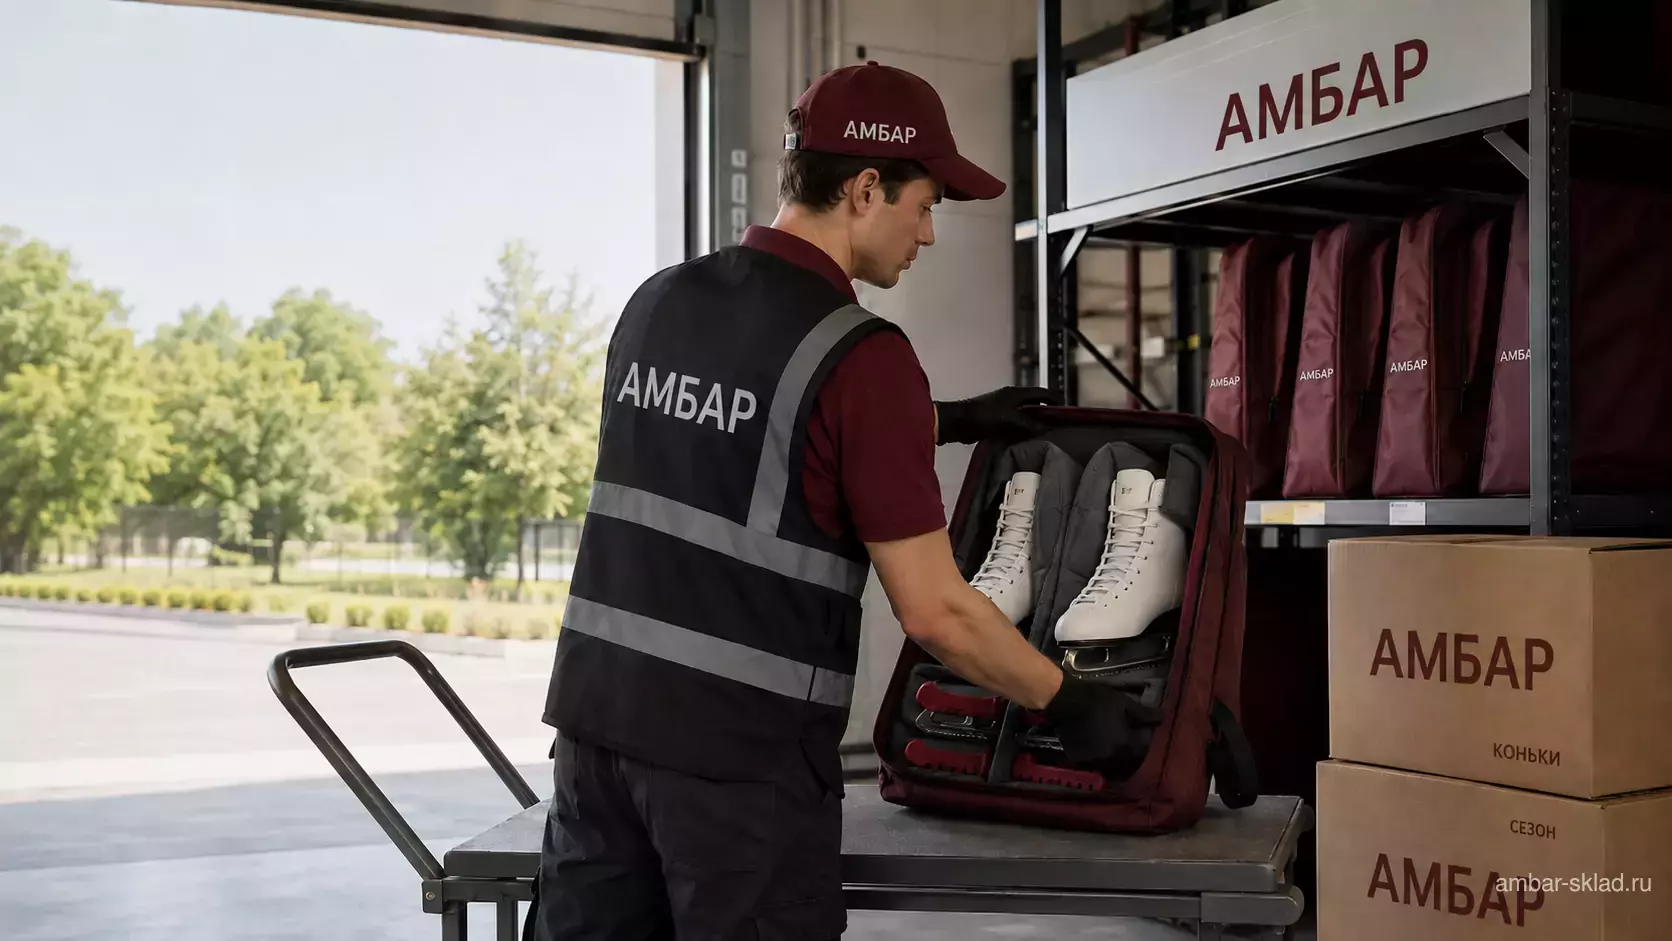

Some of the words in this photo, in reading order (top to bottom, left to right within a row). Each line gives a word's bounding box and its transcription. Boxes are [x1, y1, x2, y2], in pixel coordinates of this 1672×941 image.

[1216, 38, 1428, 151] АМБАР
[843, 120, 917, 144] АМБАР
[1390, 359, 1428, 373] АМБАР
[1500, 349, 1531, 362] АМБА
[1209, 376, 1241, 388] АМБАР
[1300, 368, 1334, 380] АМБАР
[617, 361, 757, 433] АМБАР
[1369, 628, 1555, 691] АМБАР
[1492, 742, 1561, 767] КОНЬКИ
[1509, 819, 1556, 840] СЕЗОН
[1367, 853, 1545, 928] АМБАР
